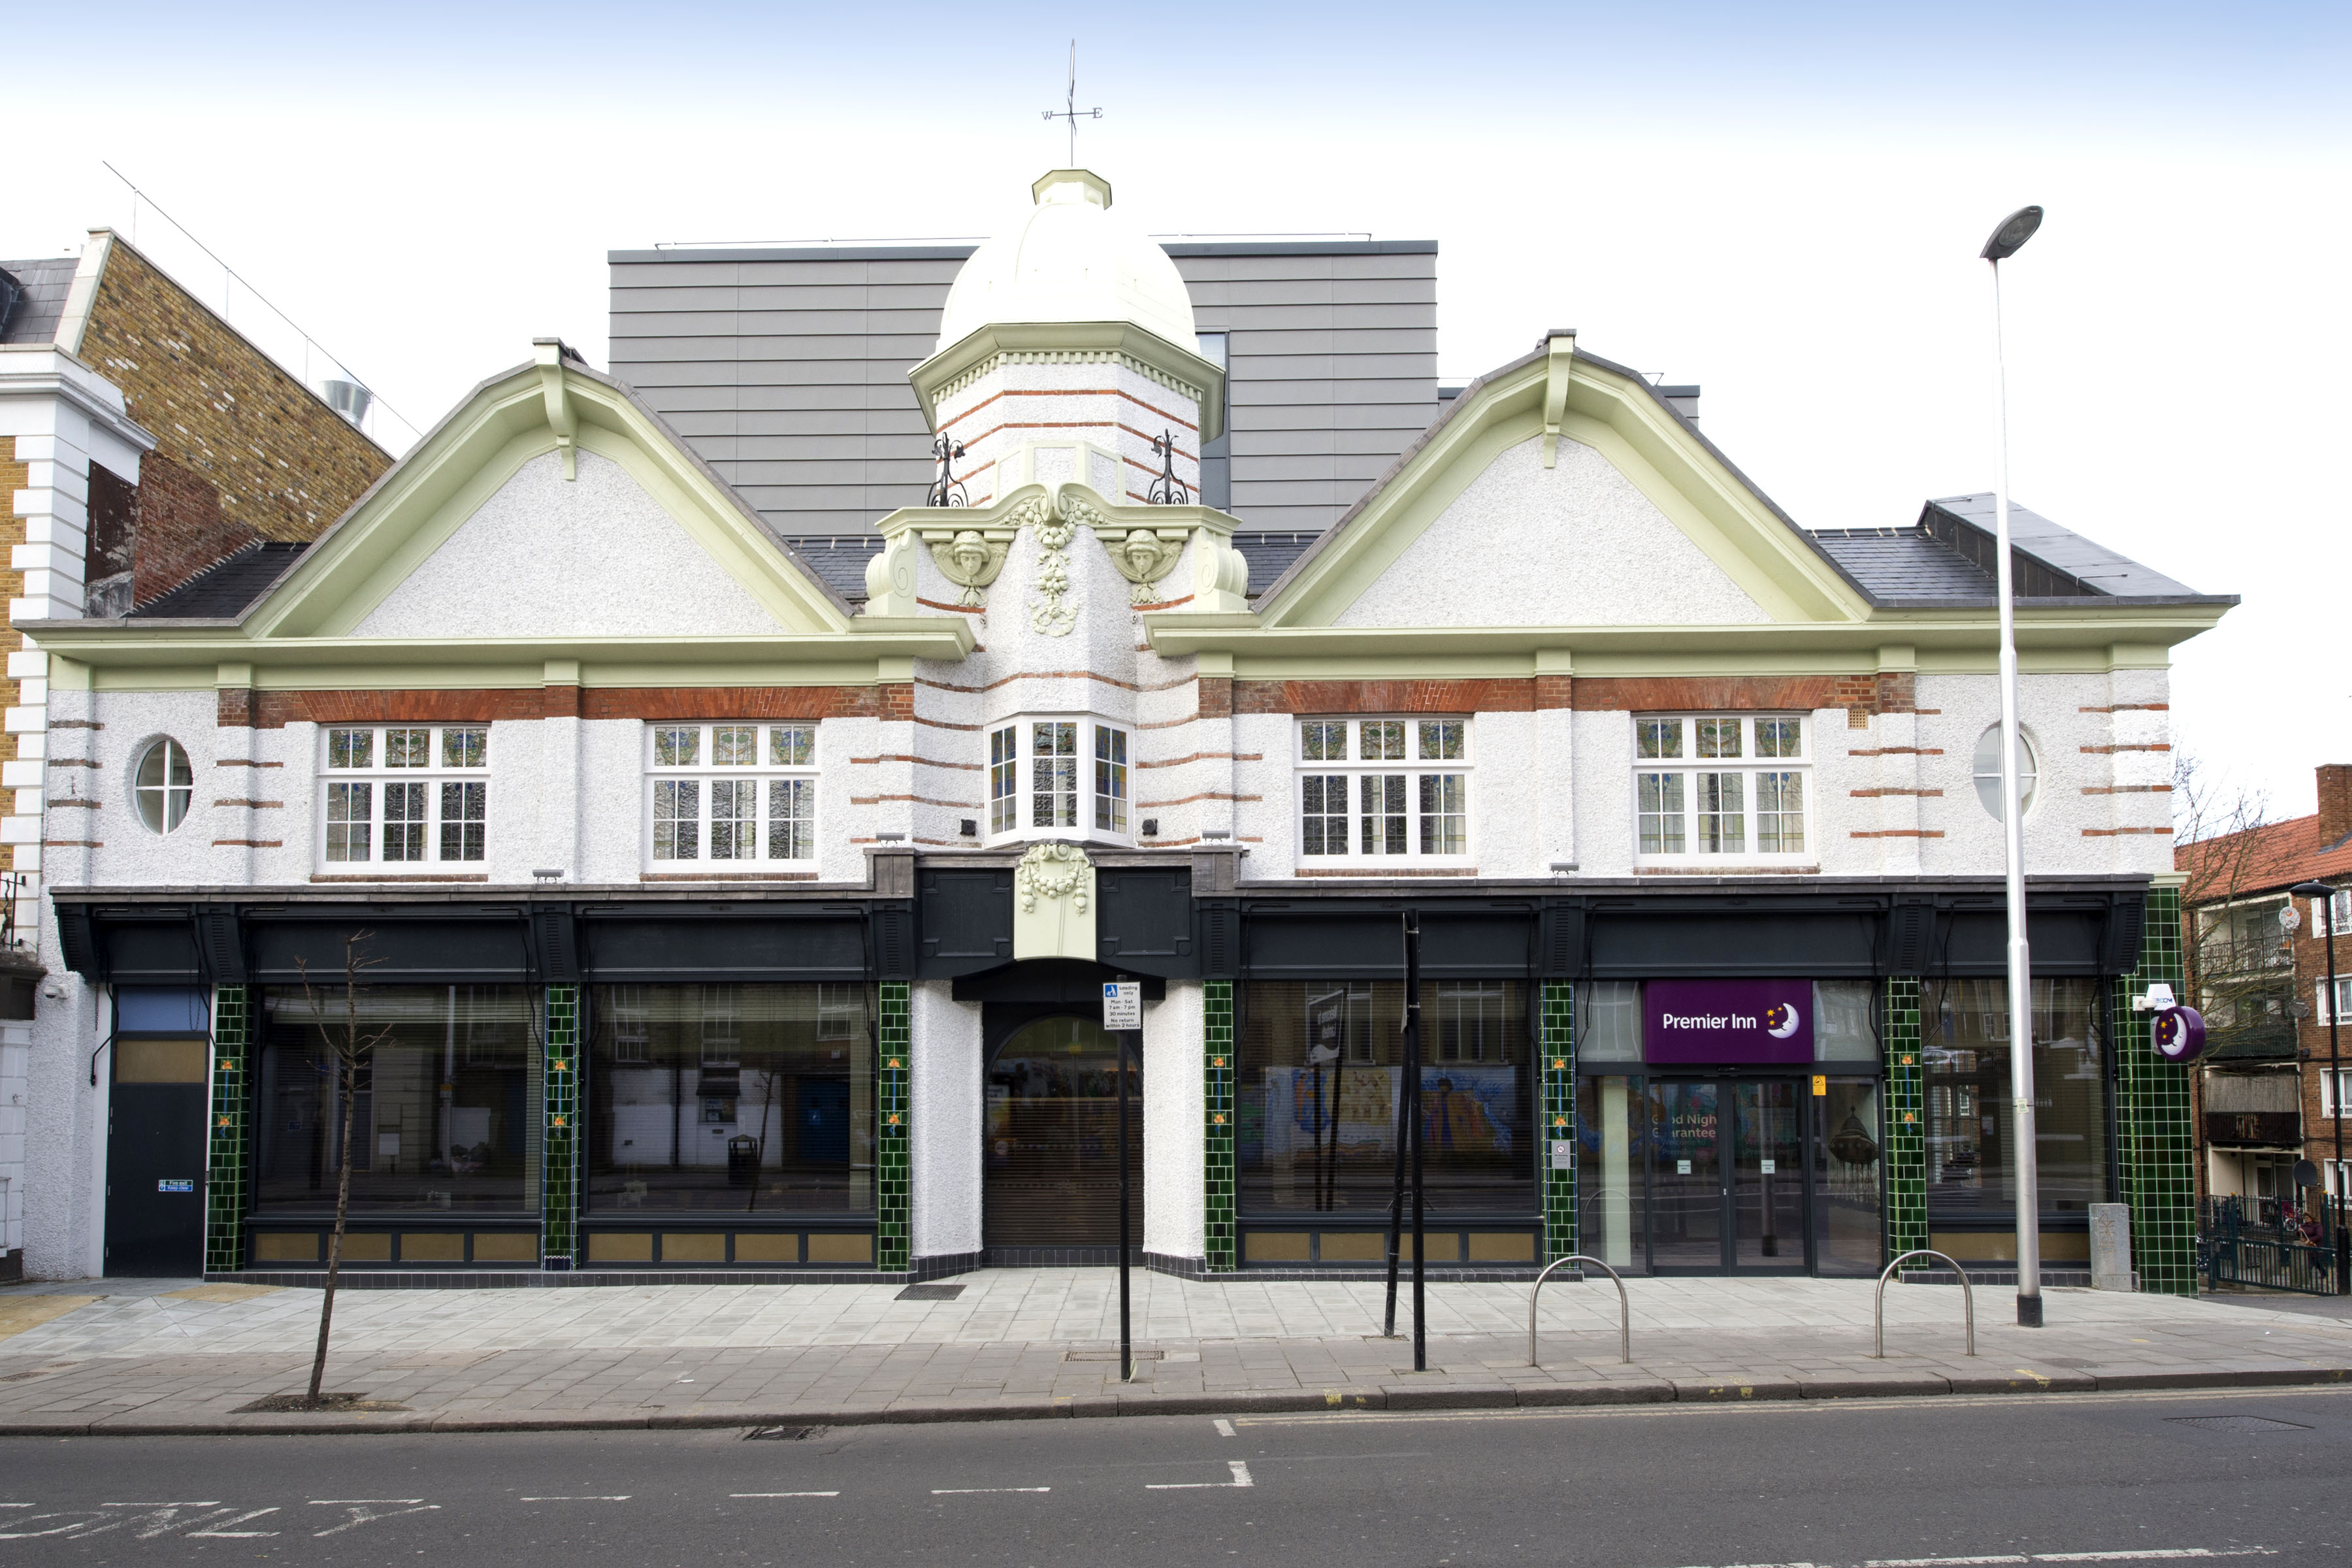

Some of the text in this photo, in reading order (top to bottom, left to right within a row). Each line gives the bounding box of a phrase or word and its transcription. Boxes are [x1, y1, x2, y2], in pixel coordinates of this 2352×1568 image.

[1092, 107, 1103, 119] E
[1663, 1013, 1757, 1029] Premier Inn
